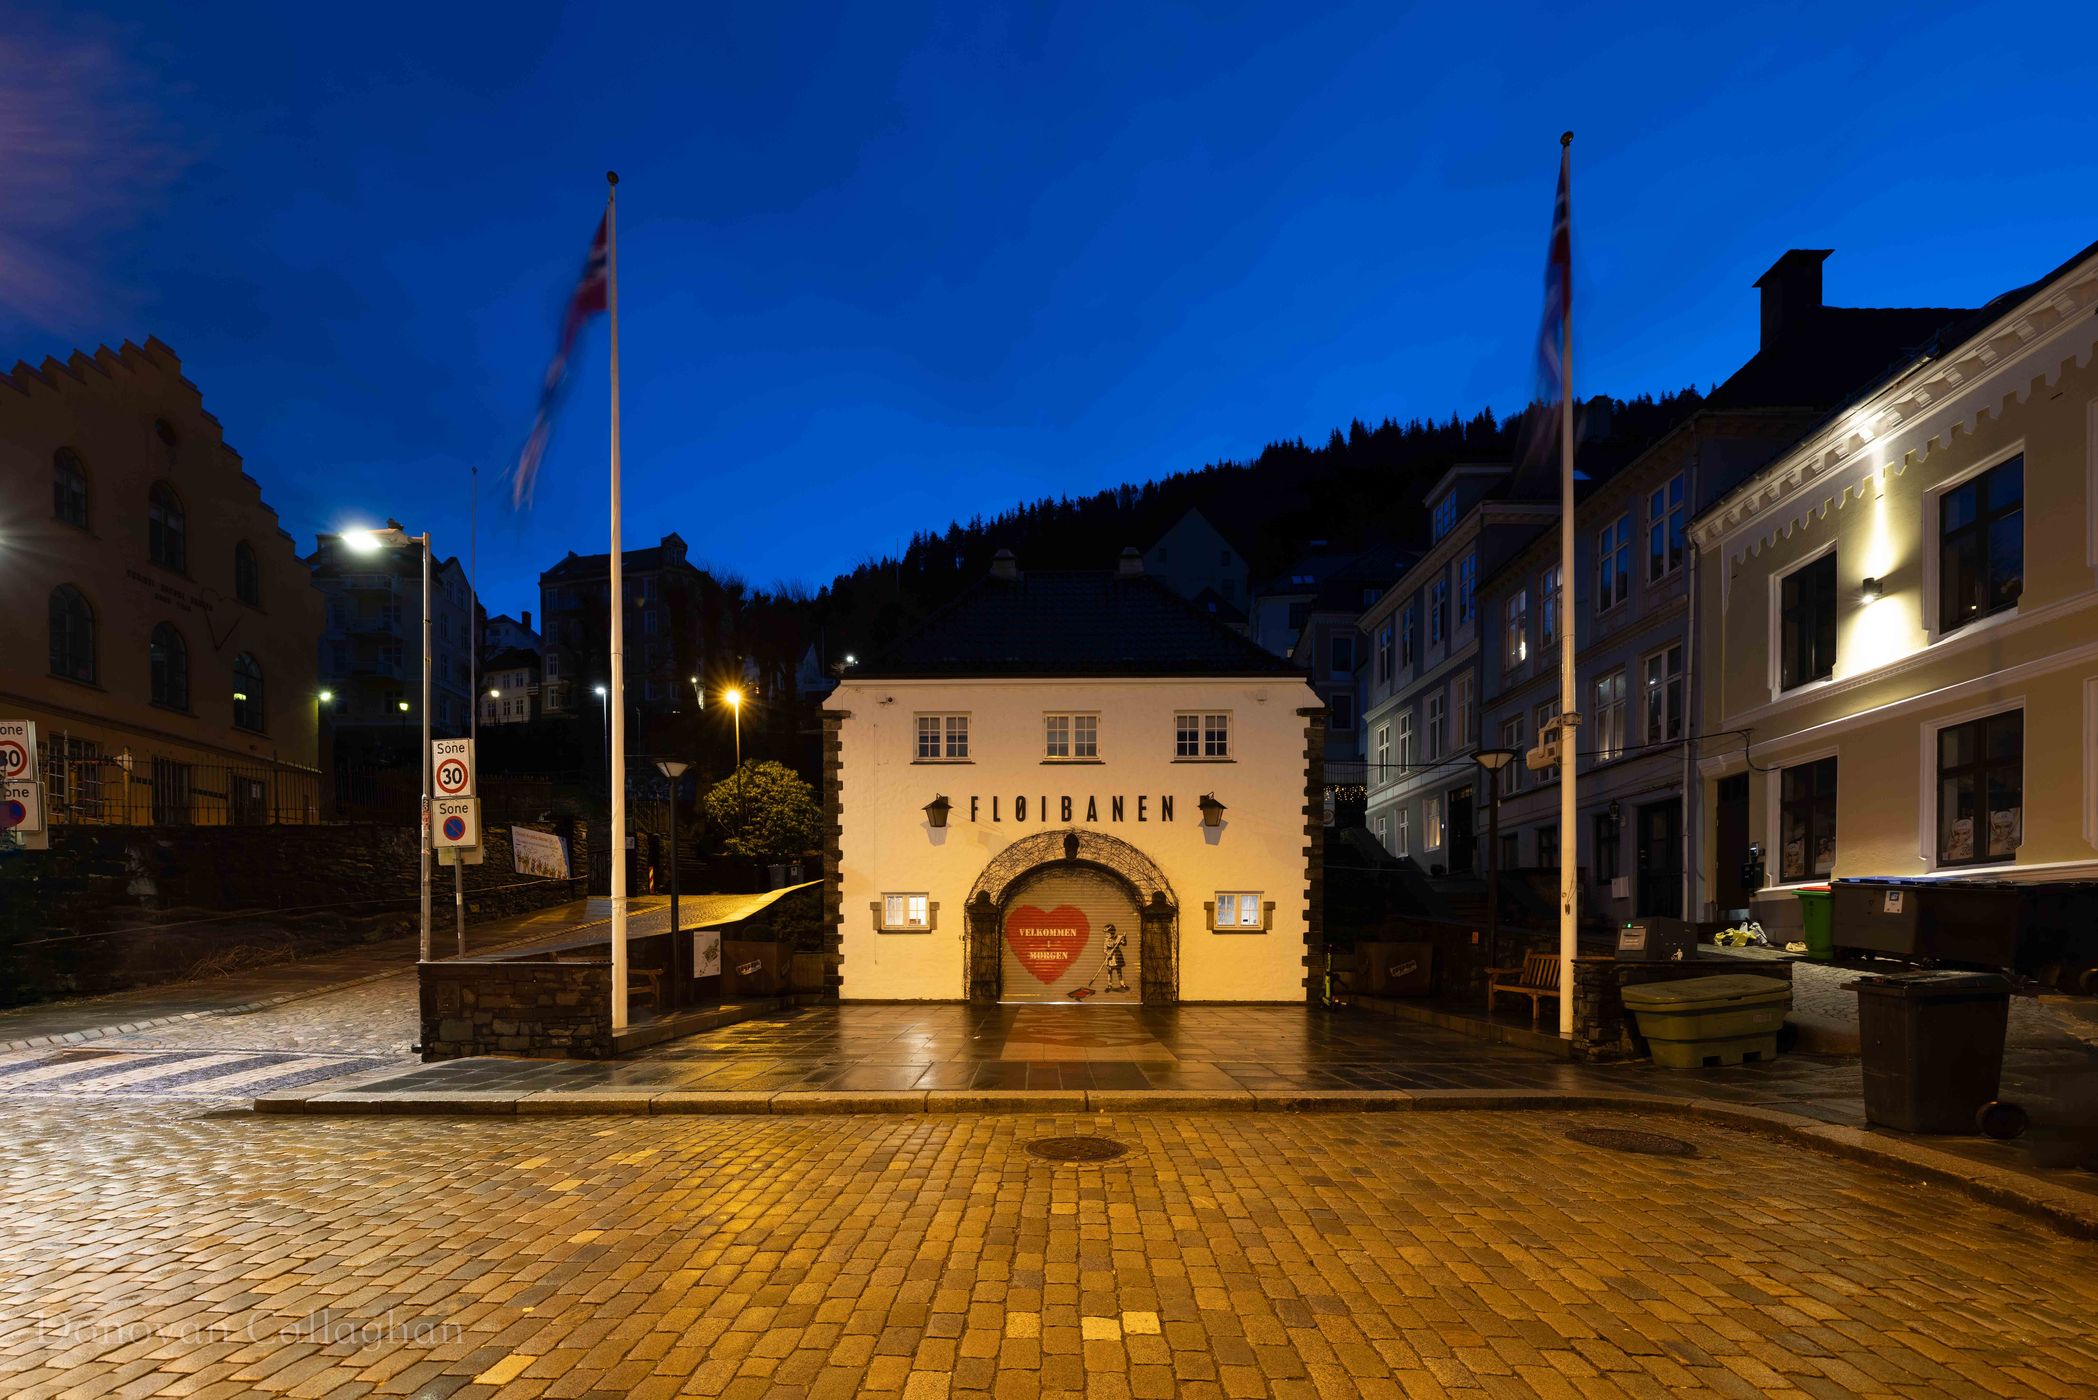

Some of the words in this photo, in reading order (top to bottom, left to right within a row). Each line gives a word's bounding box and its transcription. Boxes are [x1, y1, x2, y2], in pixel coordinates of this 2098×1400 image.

[0, 726, 23, 735] one
[437, 743, 465, 754] Sone
[442, 767, 463, 785] 30
[4, 788, 29, 798] one
[439, 803, 469, 815] Sone
[970, 795, 1174, 822] FLØIBANEN
[1019, 928, 1077, 937] VELKOMMEN
[1029, 951, 1069, 960] MORGEN
